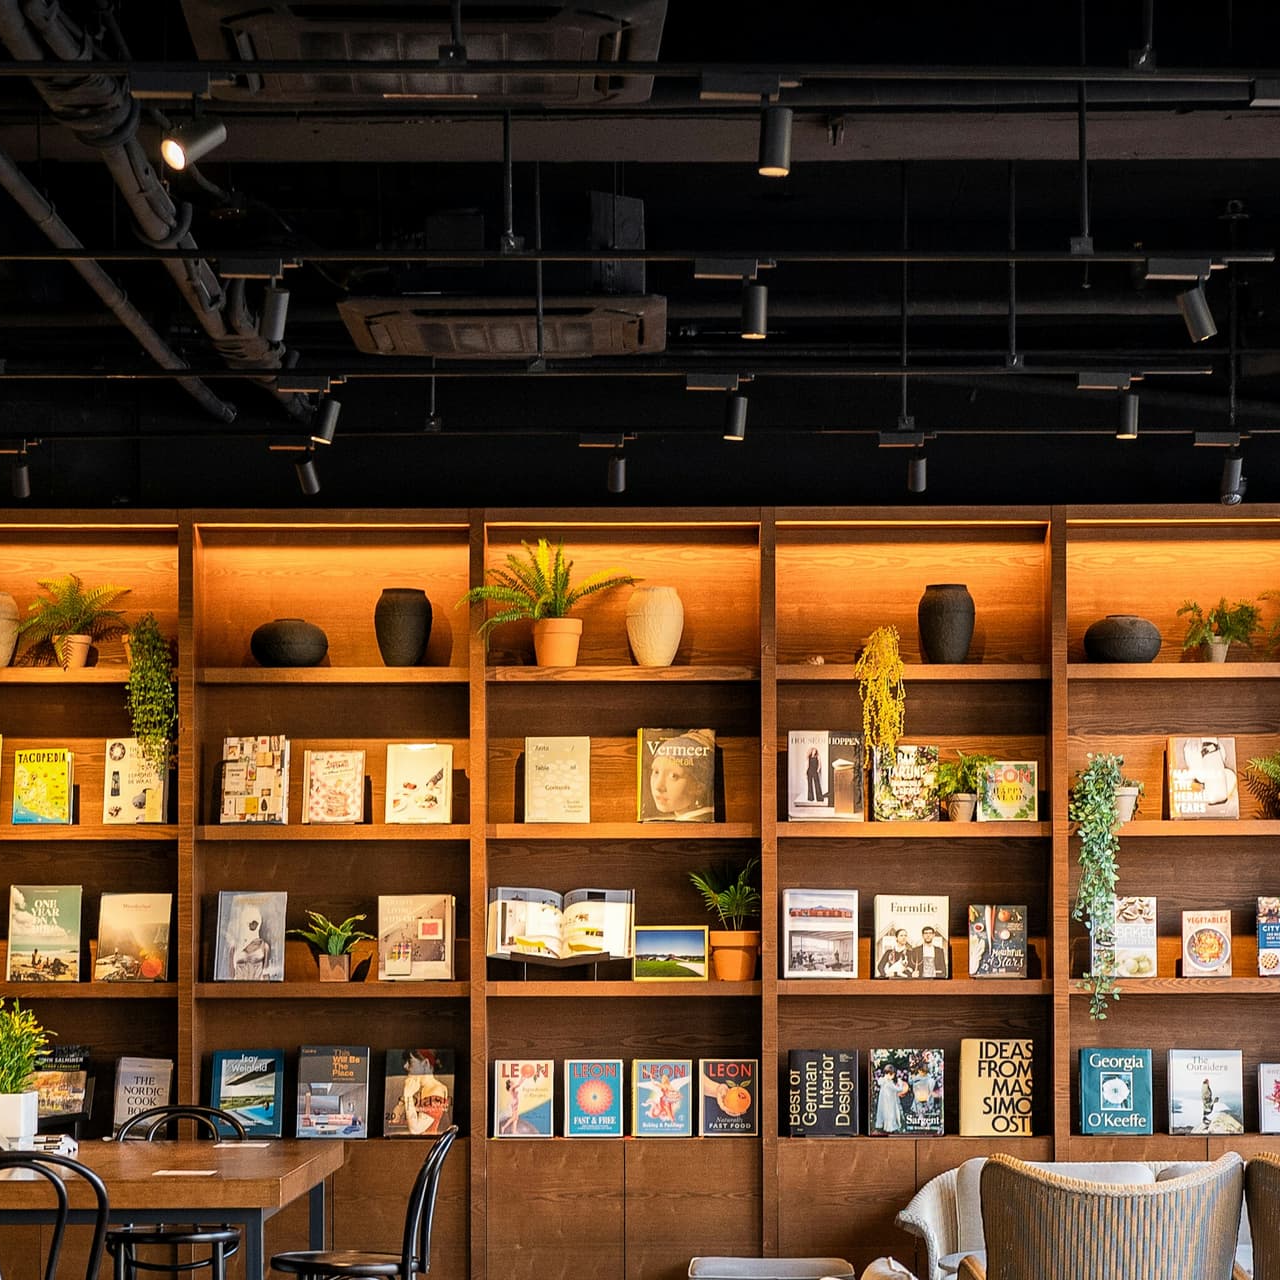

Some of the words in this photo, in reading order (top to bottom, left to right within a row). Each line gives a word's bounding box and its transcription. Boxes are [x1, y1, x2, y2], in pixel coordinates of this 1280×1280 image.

[828, 737, 860, 746] HOPPEN
[646, 741, 710, 757] Vermeer
[18, 752, 66, 764] TACOPEDIA
[986, 768, 1032, 783] LEON
[993, 786, 1024, 794] HAPPY
[1175, 803, 1206, 813] YEARS
[34, 899, 57, 909] ONE
[890, 902, 938, 913] Farmlife
[31, 908, 60, 917] YEAR
[32, 916, 47, 925] ON
[1186, 916, 1228, 924] VEGETABLES
[979, 1041, 1033, 1060] IDEAS
[332, 1056, 348, 1064] Will
[349, 1056, 361, 1064] Be
[1089, 1053, 1144, 1071] Georgia
[1192, 1055, 1208, 1064] The
[332, 1069, 354, 1077] Place
[501, 1063, 549, 1079] LEON
[573, 1063, 617, 1078] LEON
[642, 1064, 686, 1079] LEON
[708, 1063, 752, 1078] LEON
[978, 1060, 1033, 1078] FROM
[1186, 1063, 1228, 1072] Outsiders
[133, 1076, 156, 1085] THE
[819, 1053, 834, 1109] Interior
[123, 1086, 164, 1097] NORDIC
[802, 1061, 817, 1127] German
[992, 1079, 1033, 1096] MAS
[127, 1096, 157, 1106] COOK
[835, 1071, 854, 1127] Design
[789, 1090, 801, 1126] Best
[982, 1097, 1033, 1115] SIMO
[574, 1116, 589, 1125] FAST
[590, 1116, 597, 1125] &
[598, 1116, 616, 1125] FREE
[906, 1114, 940, 1127] Sargent
[992, 1115, 1033, 1133] OSTI
[1088, 1112, 1147, 1128] O'Keeffe
